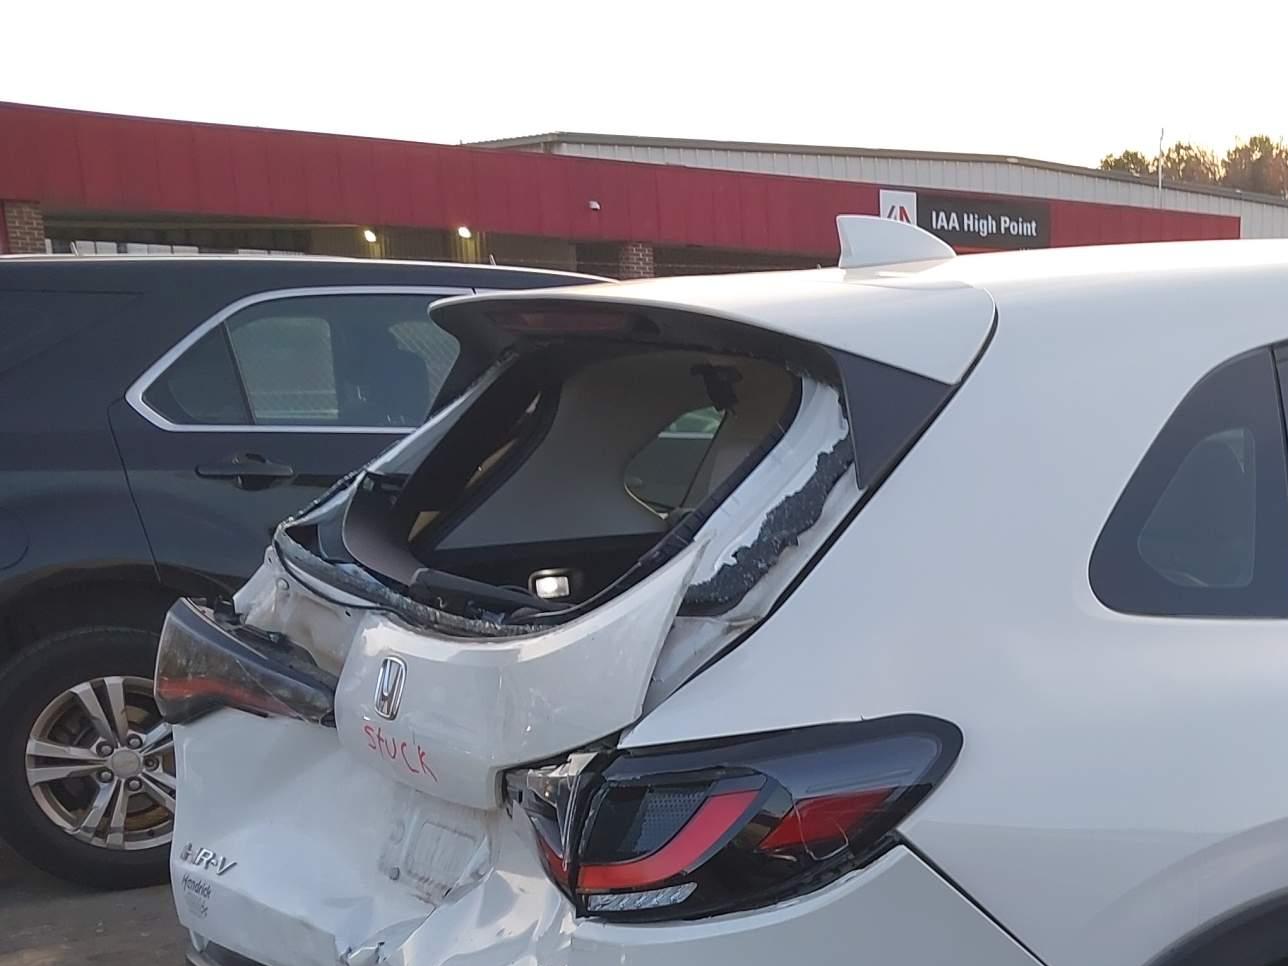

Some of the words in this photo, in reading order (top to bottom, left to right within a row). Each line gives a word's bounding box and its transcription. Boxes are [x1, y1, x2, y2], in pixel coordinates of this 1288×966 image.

[932, 210, 960, 231] IAA
[963, 212, 997, 237] High
[1000, 215, 1037, 236] Point
[180, 842, 238, 876] HR-V
